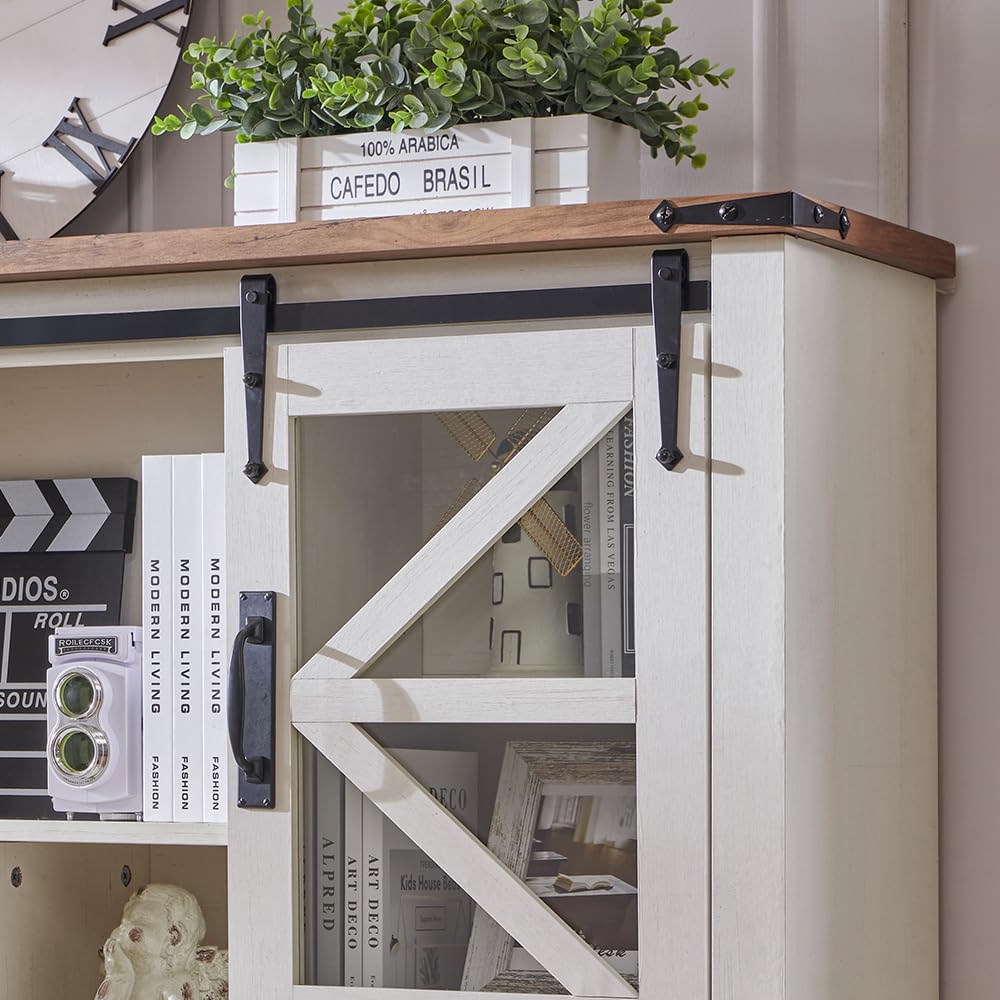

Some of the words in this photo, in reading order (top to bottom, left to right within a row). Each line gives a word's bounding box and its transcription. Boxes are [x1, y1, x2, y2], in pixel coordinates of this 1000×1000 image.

[361, 140, 395, 157] 100%
[399, 134, 459, 154] ARABICA
[330, 171, 400, 199] CAFEDO
[423, 165, 491, 193] BRASIL
[583, 502, 593, 533] flower
[606, 493, 615, 523] FROM
[607, 528, 615, 549] LAS
[607, 553, 616, 591] VEGAS
[34, 612, 85, 629] ROLL
[150, 559, 160, 639] MODERN
[180, 559, 190, 639] MODERN
[211, 558, 220, 638] MODERN
[151, 651, 160, 713] LIVING
[181, 651, 190, 713] LIVING
[211, 650, 221, 713] LIVING
[181, 756, 189, 810] FASHION
[212, 757, 220, 810] FASHION
[322, 837, 335, 931] ALPRED
[348, 856, 357, 891] ART
[368, 854, 379, 889] ART
[400, 874, 416, 890] Kids
[418, 875, 441, 890] House
[347, 901, 358, 949] DECO
[368, 900, 379, 948] DECO
